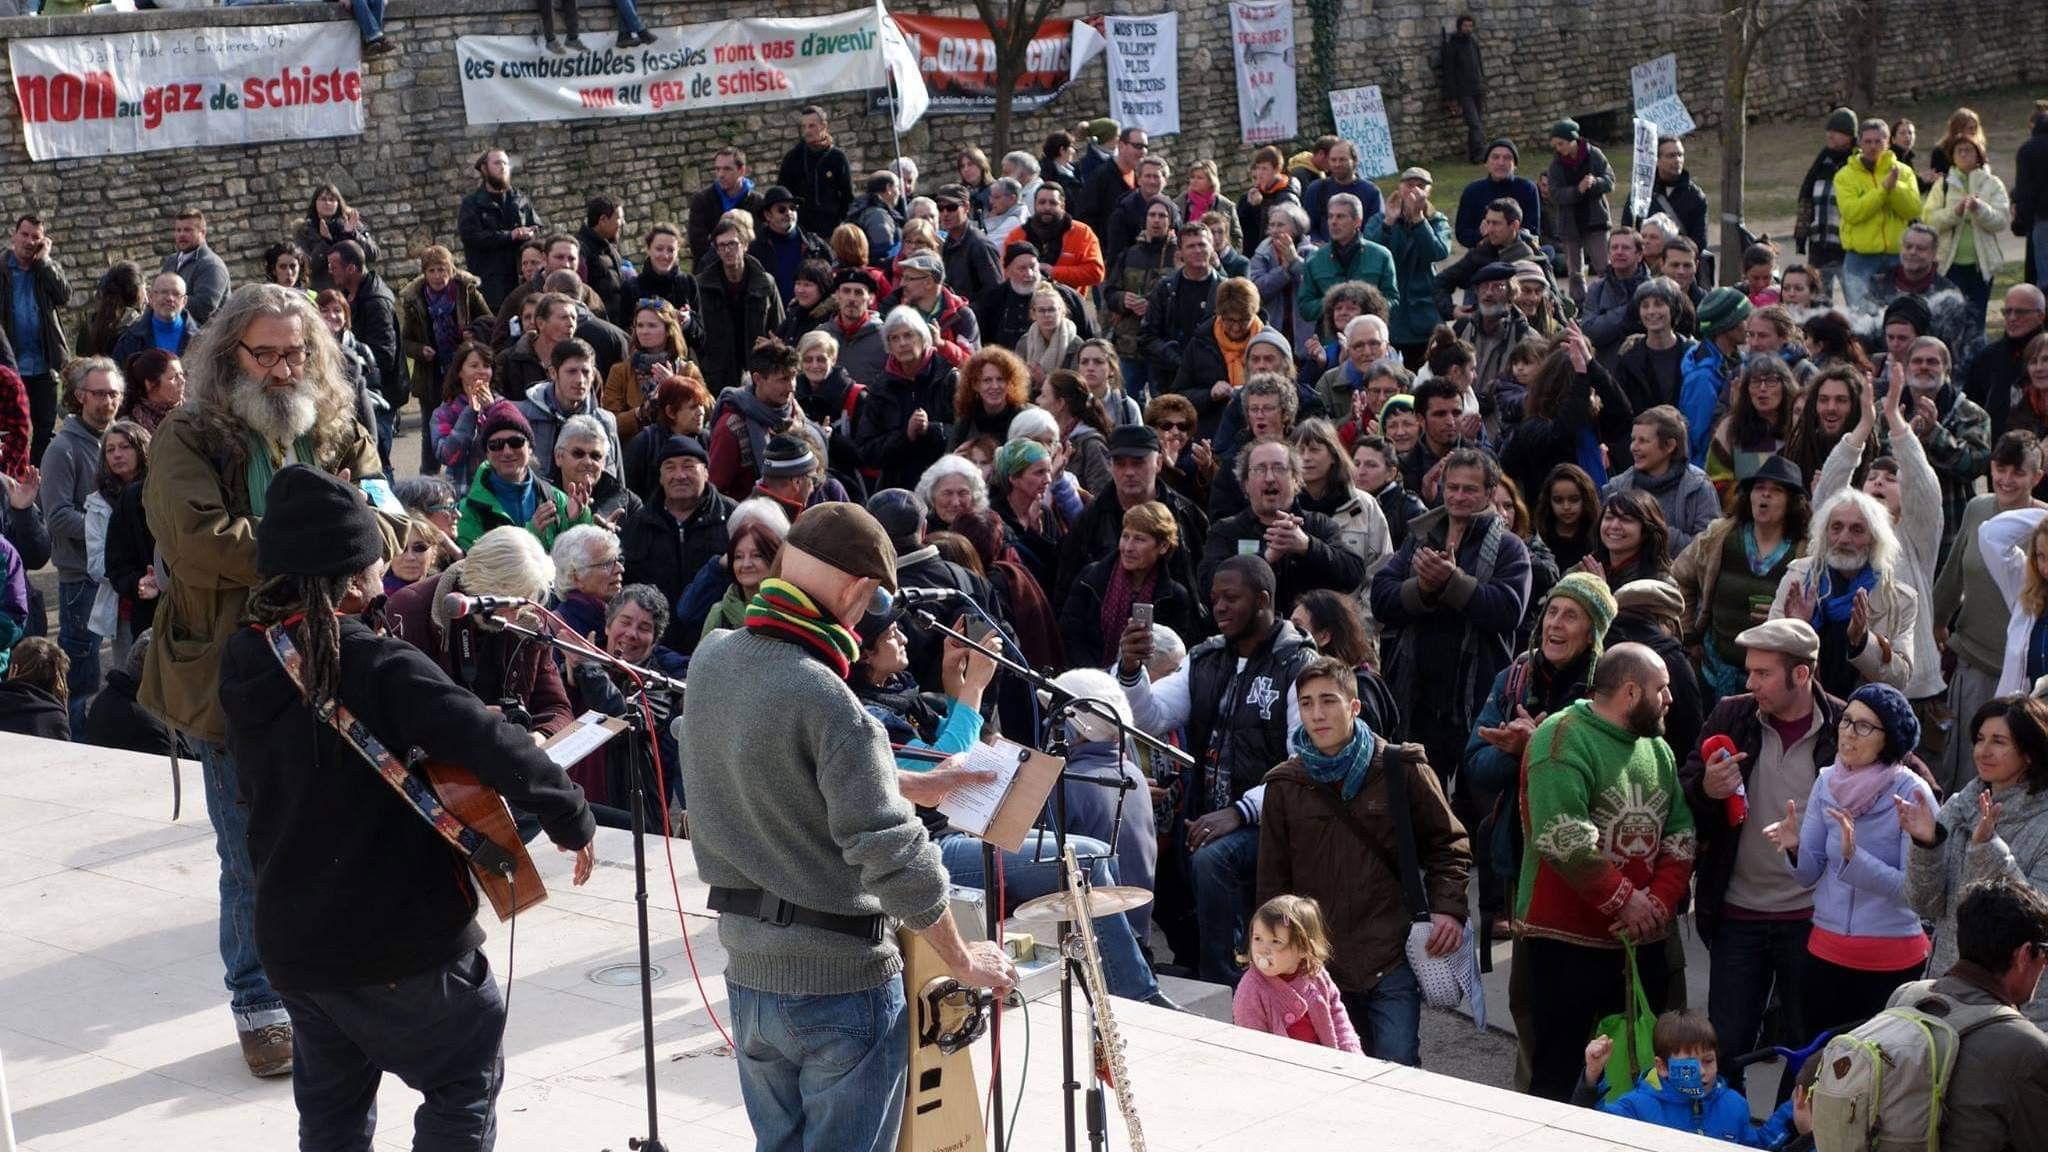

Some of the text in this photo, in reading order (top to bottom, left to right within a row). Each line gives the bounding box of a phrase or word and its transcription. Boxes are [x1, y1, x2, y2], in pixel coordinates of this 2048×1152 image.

[1114, 22, 1158, 36] NOS VIES
[172, 40, 188, 55] de
[464, 57, 495, 80] les
[500, 48, 635, 79] combustibles
[641, 46, 706, 77] fossiles
[714, 40, 755, 64] n'ont
[761, 38, 795, 62] pas
[801, 29, 876, 58] d'avenir
[937, 37, 978, 72] GAZ
[1117, 41, 1156, 56] VALENT
[1125, 59, 1150, 73] PLUS
[17, 66, 361, 130] non au gaz de schiste
[578, 67, 787, 109] non au gaz de schiste
[1121, 101, 1163, 115] PROFITS
[461, 629, 470, 658] Canon
